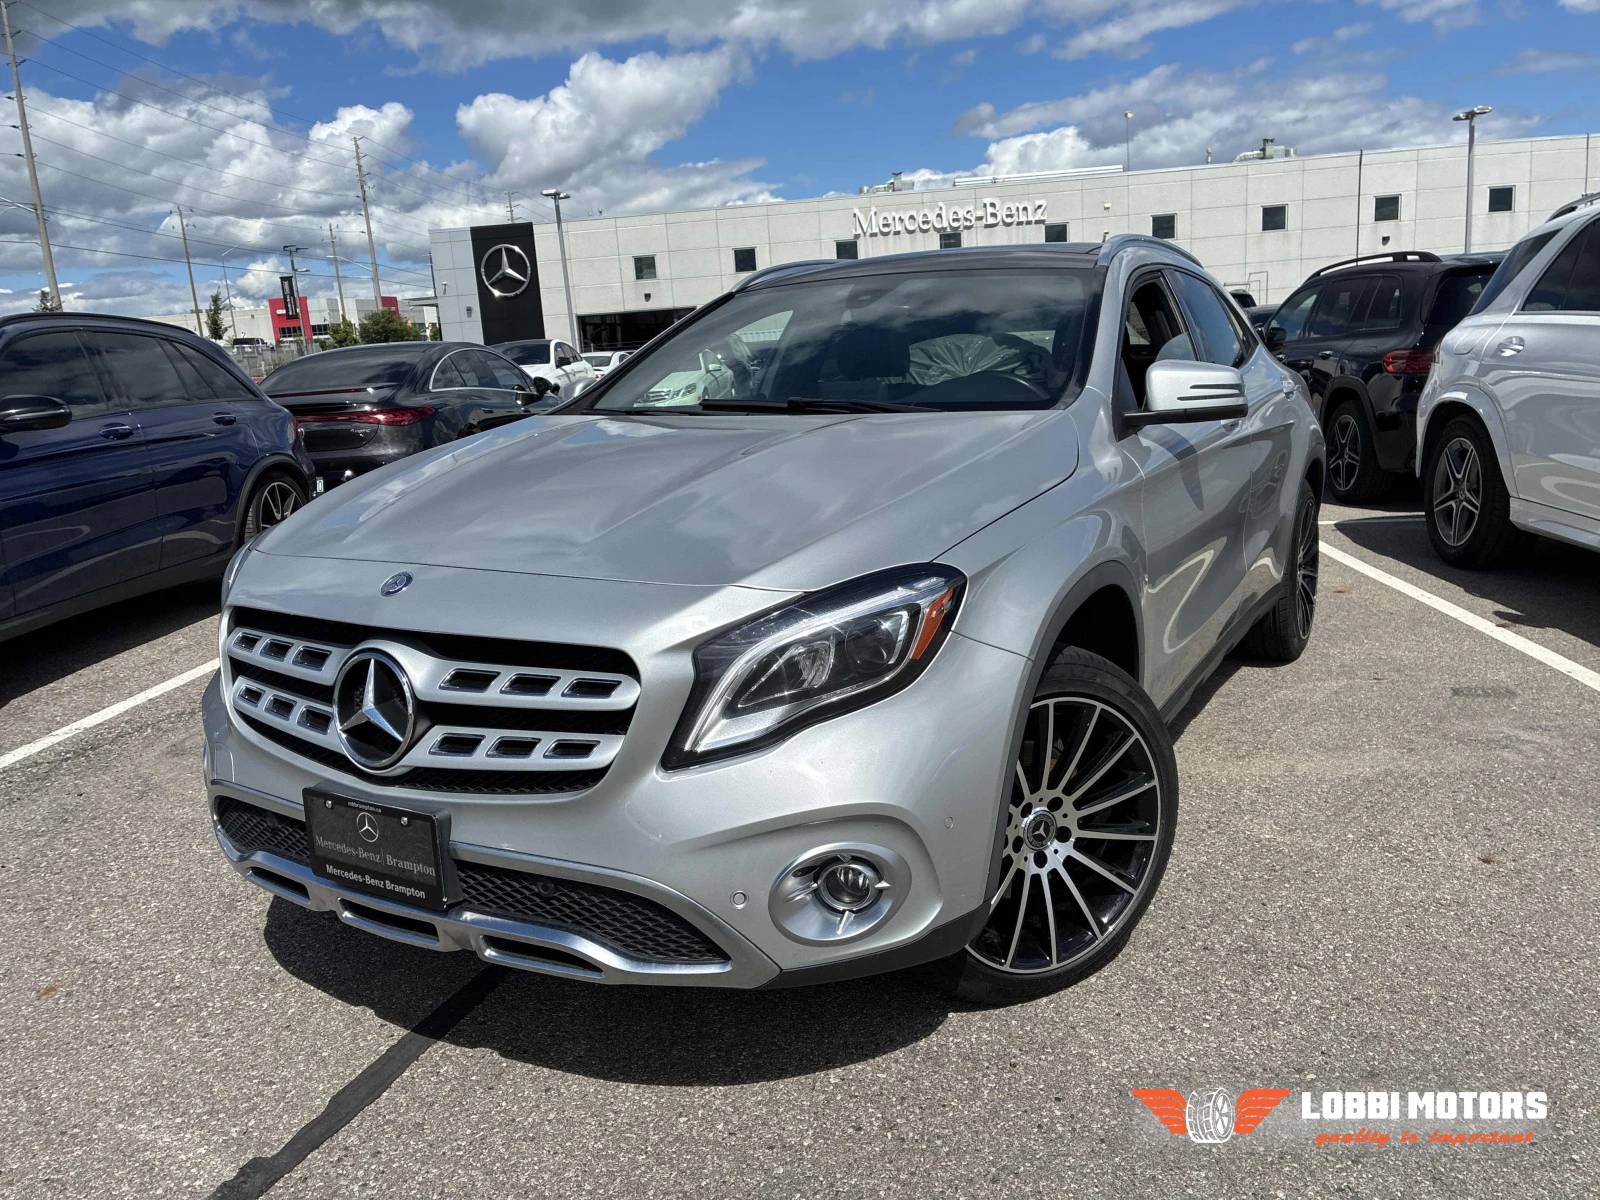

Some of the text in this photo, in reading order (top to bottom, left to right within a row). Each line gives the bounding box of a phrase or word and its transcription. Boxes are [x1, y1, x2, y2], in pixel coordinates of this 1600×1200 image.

[852, 198, 1047, 236] Mercedes-Benz
[315, 836, 436, 876] Mercedes-Benz Brampton
[326, 864, 426, 899] Mercedes-Benz Brampton
